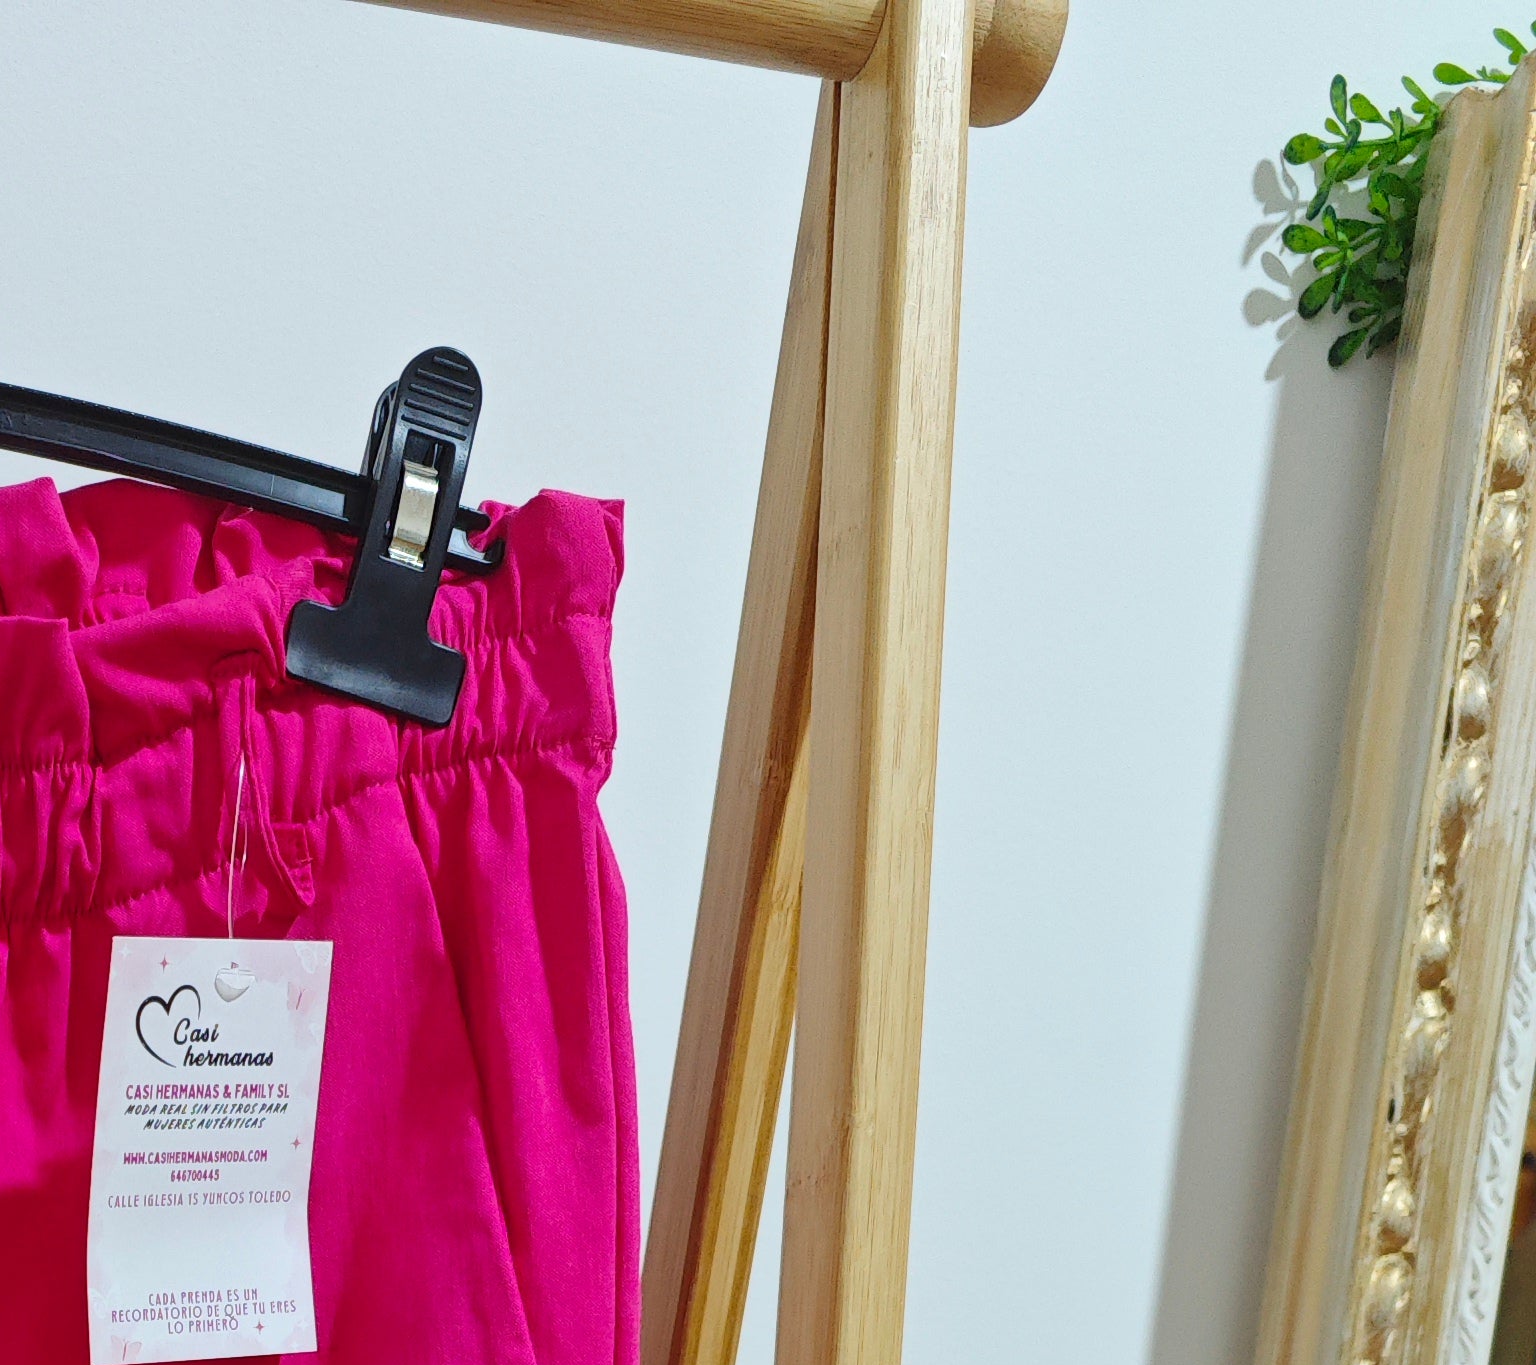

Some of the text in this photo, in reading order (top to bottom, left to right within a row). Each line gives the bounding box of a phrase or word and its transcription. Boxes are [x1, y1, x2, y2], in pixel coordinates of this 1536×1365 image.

[173, 1018, 219, 1045] Casi
[183, 1045, 274, 1067] hermanas
[126, 1084, 290, 1100] CASI HERMANAS & FAMILY SL
[124, 1103, 288, 1115] MODA REAL SIN FILTROS PARA
[143, 1116, 266, 1130] MUJERES AUTÉNTICAS
[123, 1150, 268, 1165] WWW.CASIHERMANASMODA.COM
[108, 1190, 291, 1208] CALLE IGLESIA 15 YUNCOS TOLEDO
[149, 1288, 258, 1306] CADA PRENDA ES UN
[111, 1300, 296, 1323] RECORDATORIO DE QUE TU ERES
[168, 1318, 239, 1335] LO PRIMERO
